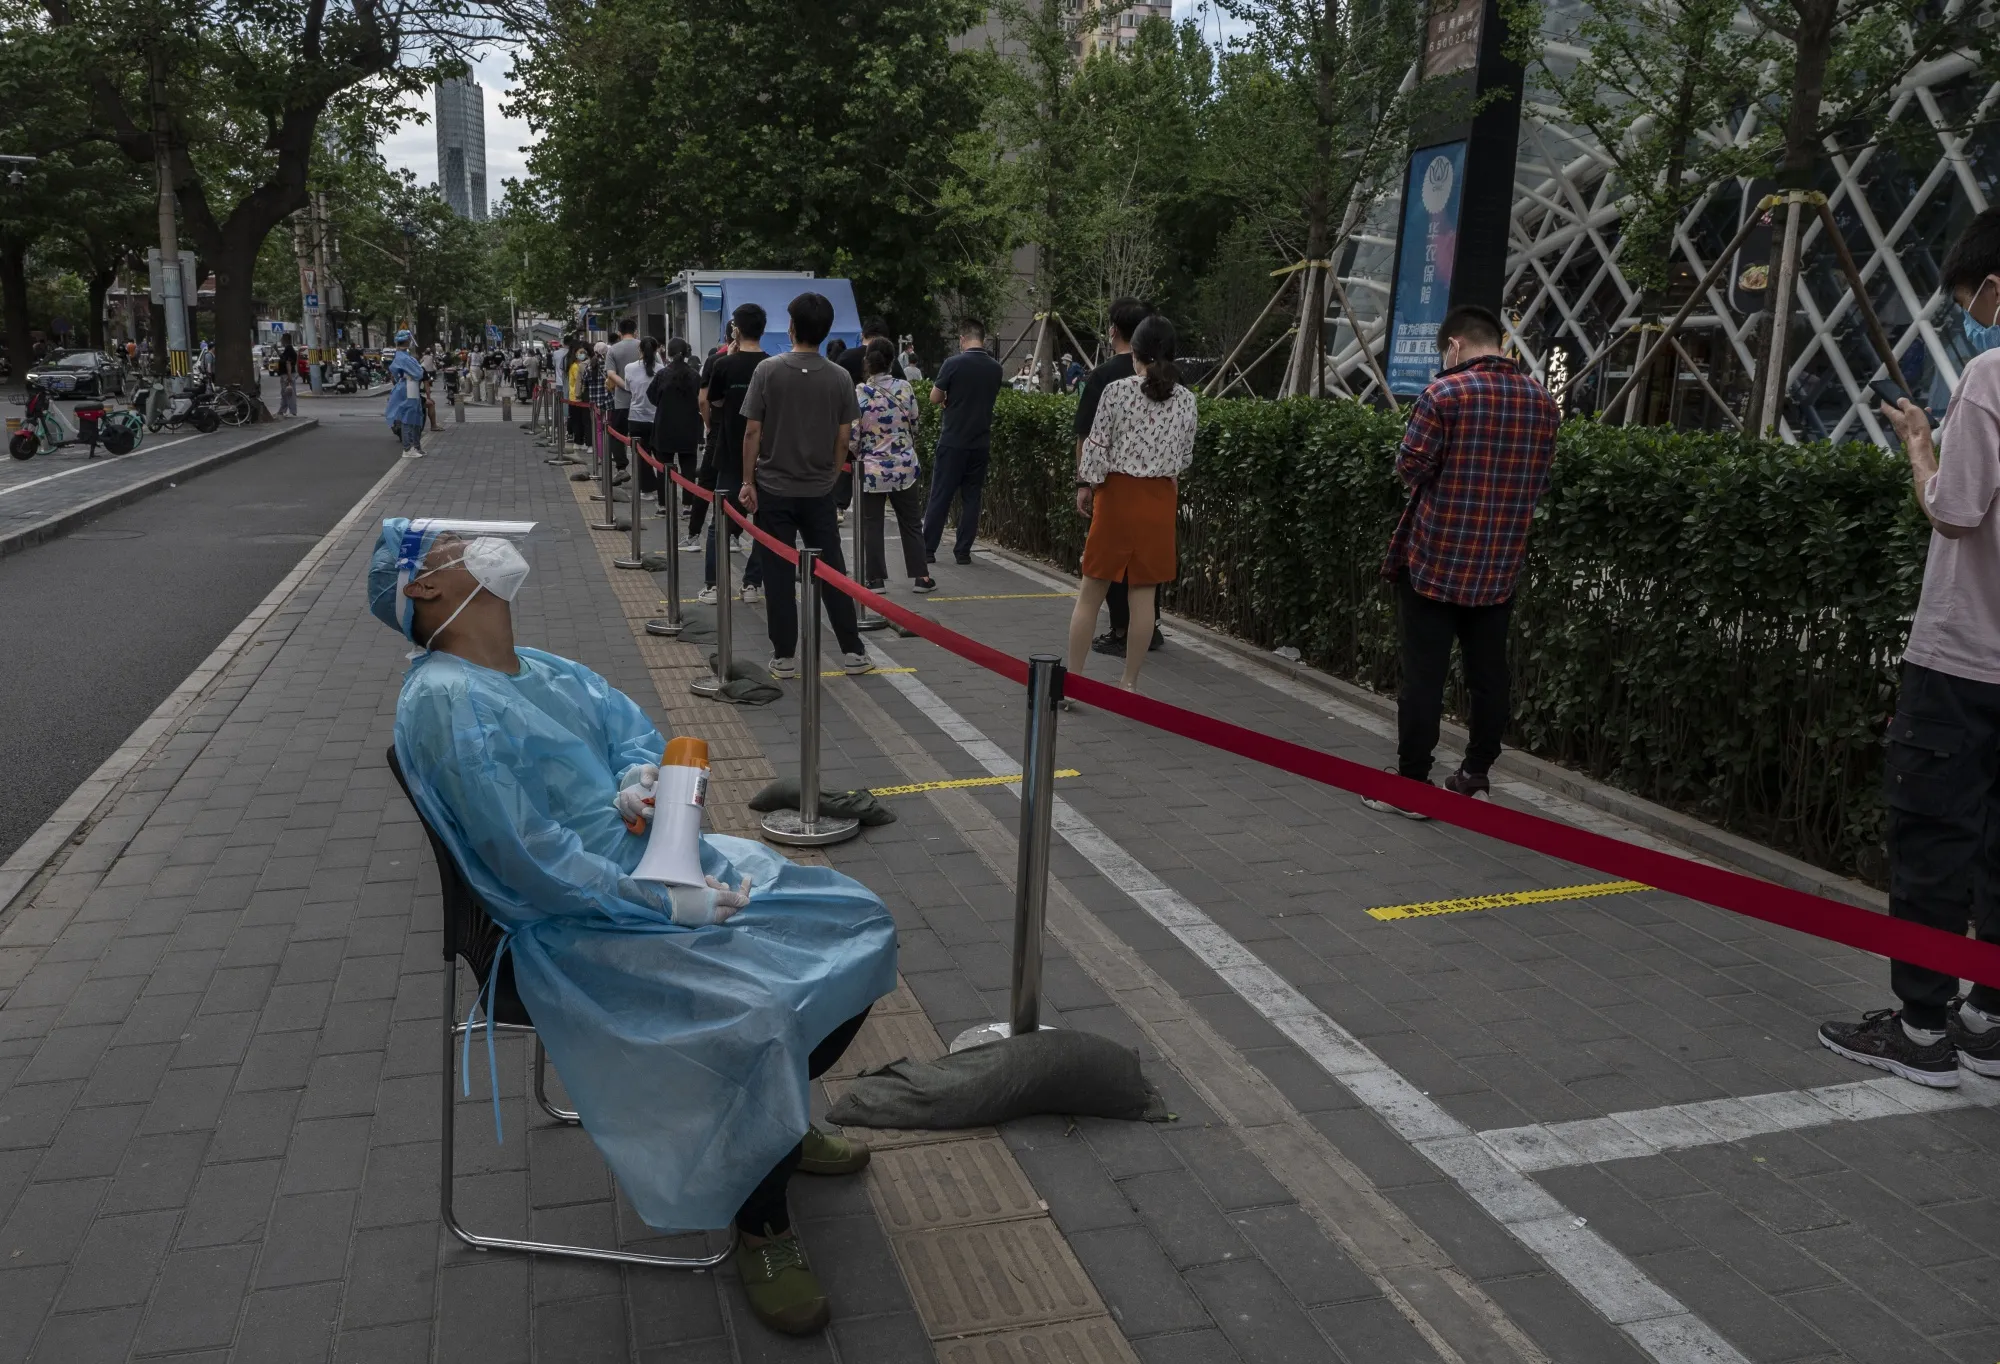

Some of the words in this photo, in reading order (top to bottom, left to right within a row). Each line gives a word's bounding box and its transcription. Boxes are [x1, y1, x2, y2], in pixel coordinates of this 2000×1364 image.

[1429, 26, 1478, 52] 65002299
[1420, 221, 1440, 304] 华农保险
